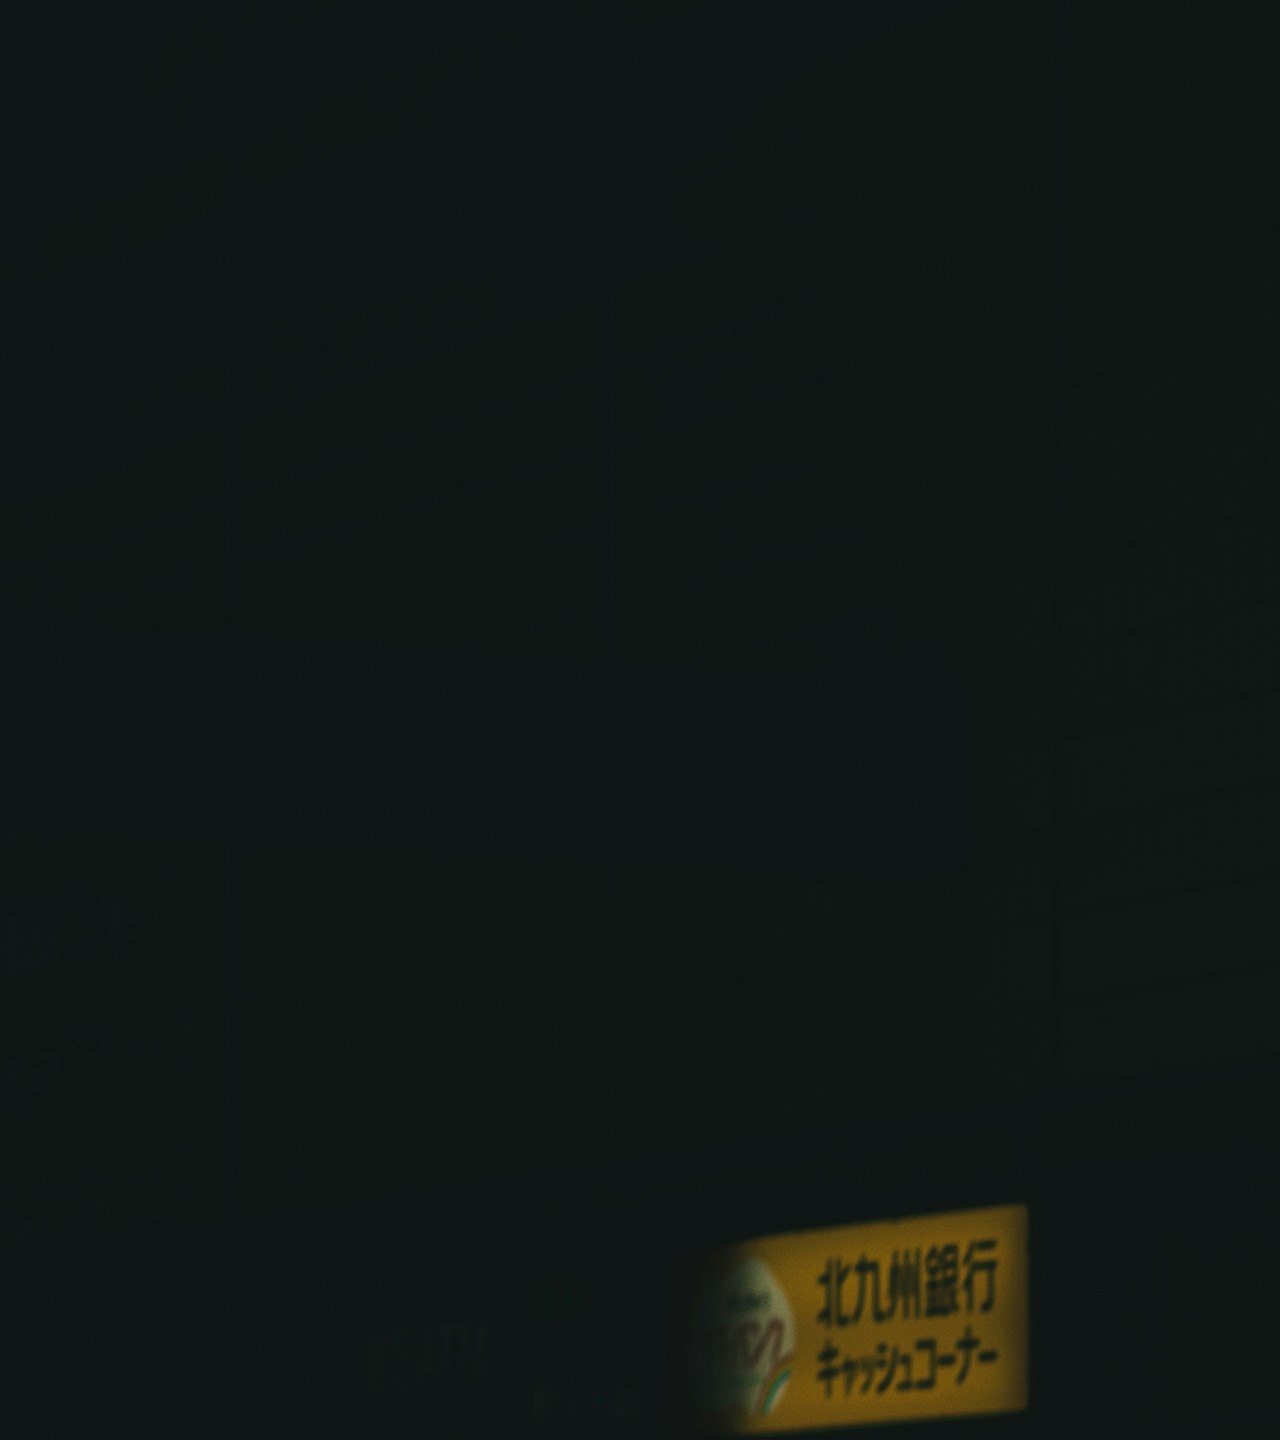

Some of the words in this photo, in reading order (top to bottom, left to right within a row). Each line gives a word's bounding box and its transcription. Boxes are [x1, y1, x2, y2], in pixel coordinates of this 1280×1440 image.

[818, 1239, 998, 1327] 北九州銀行
[818, 1328, 998, 1398] キャッシュコーナー
